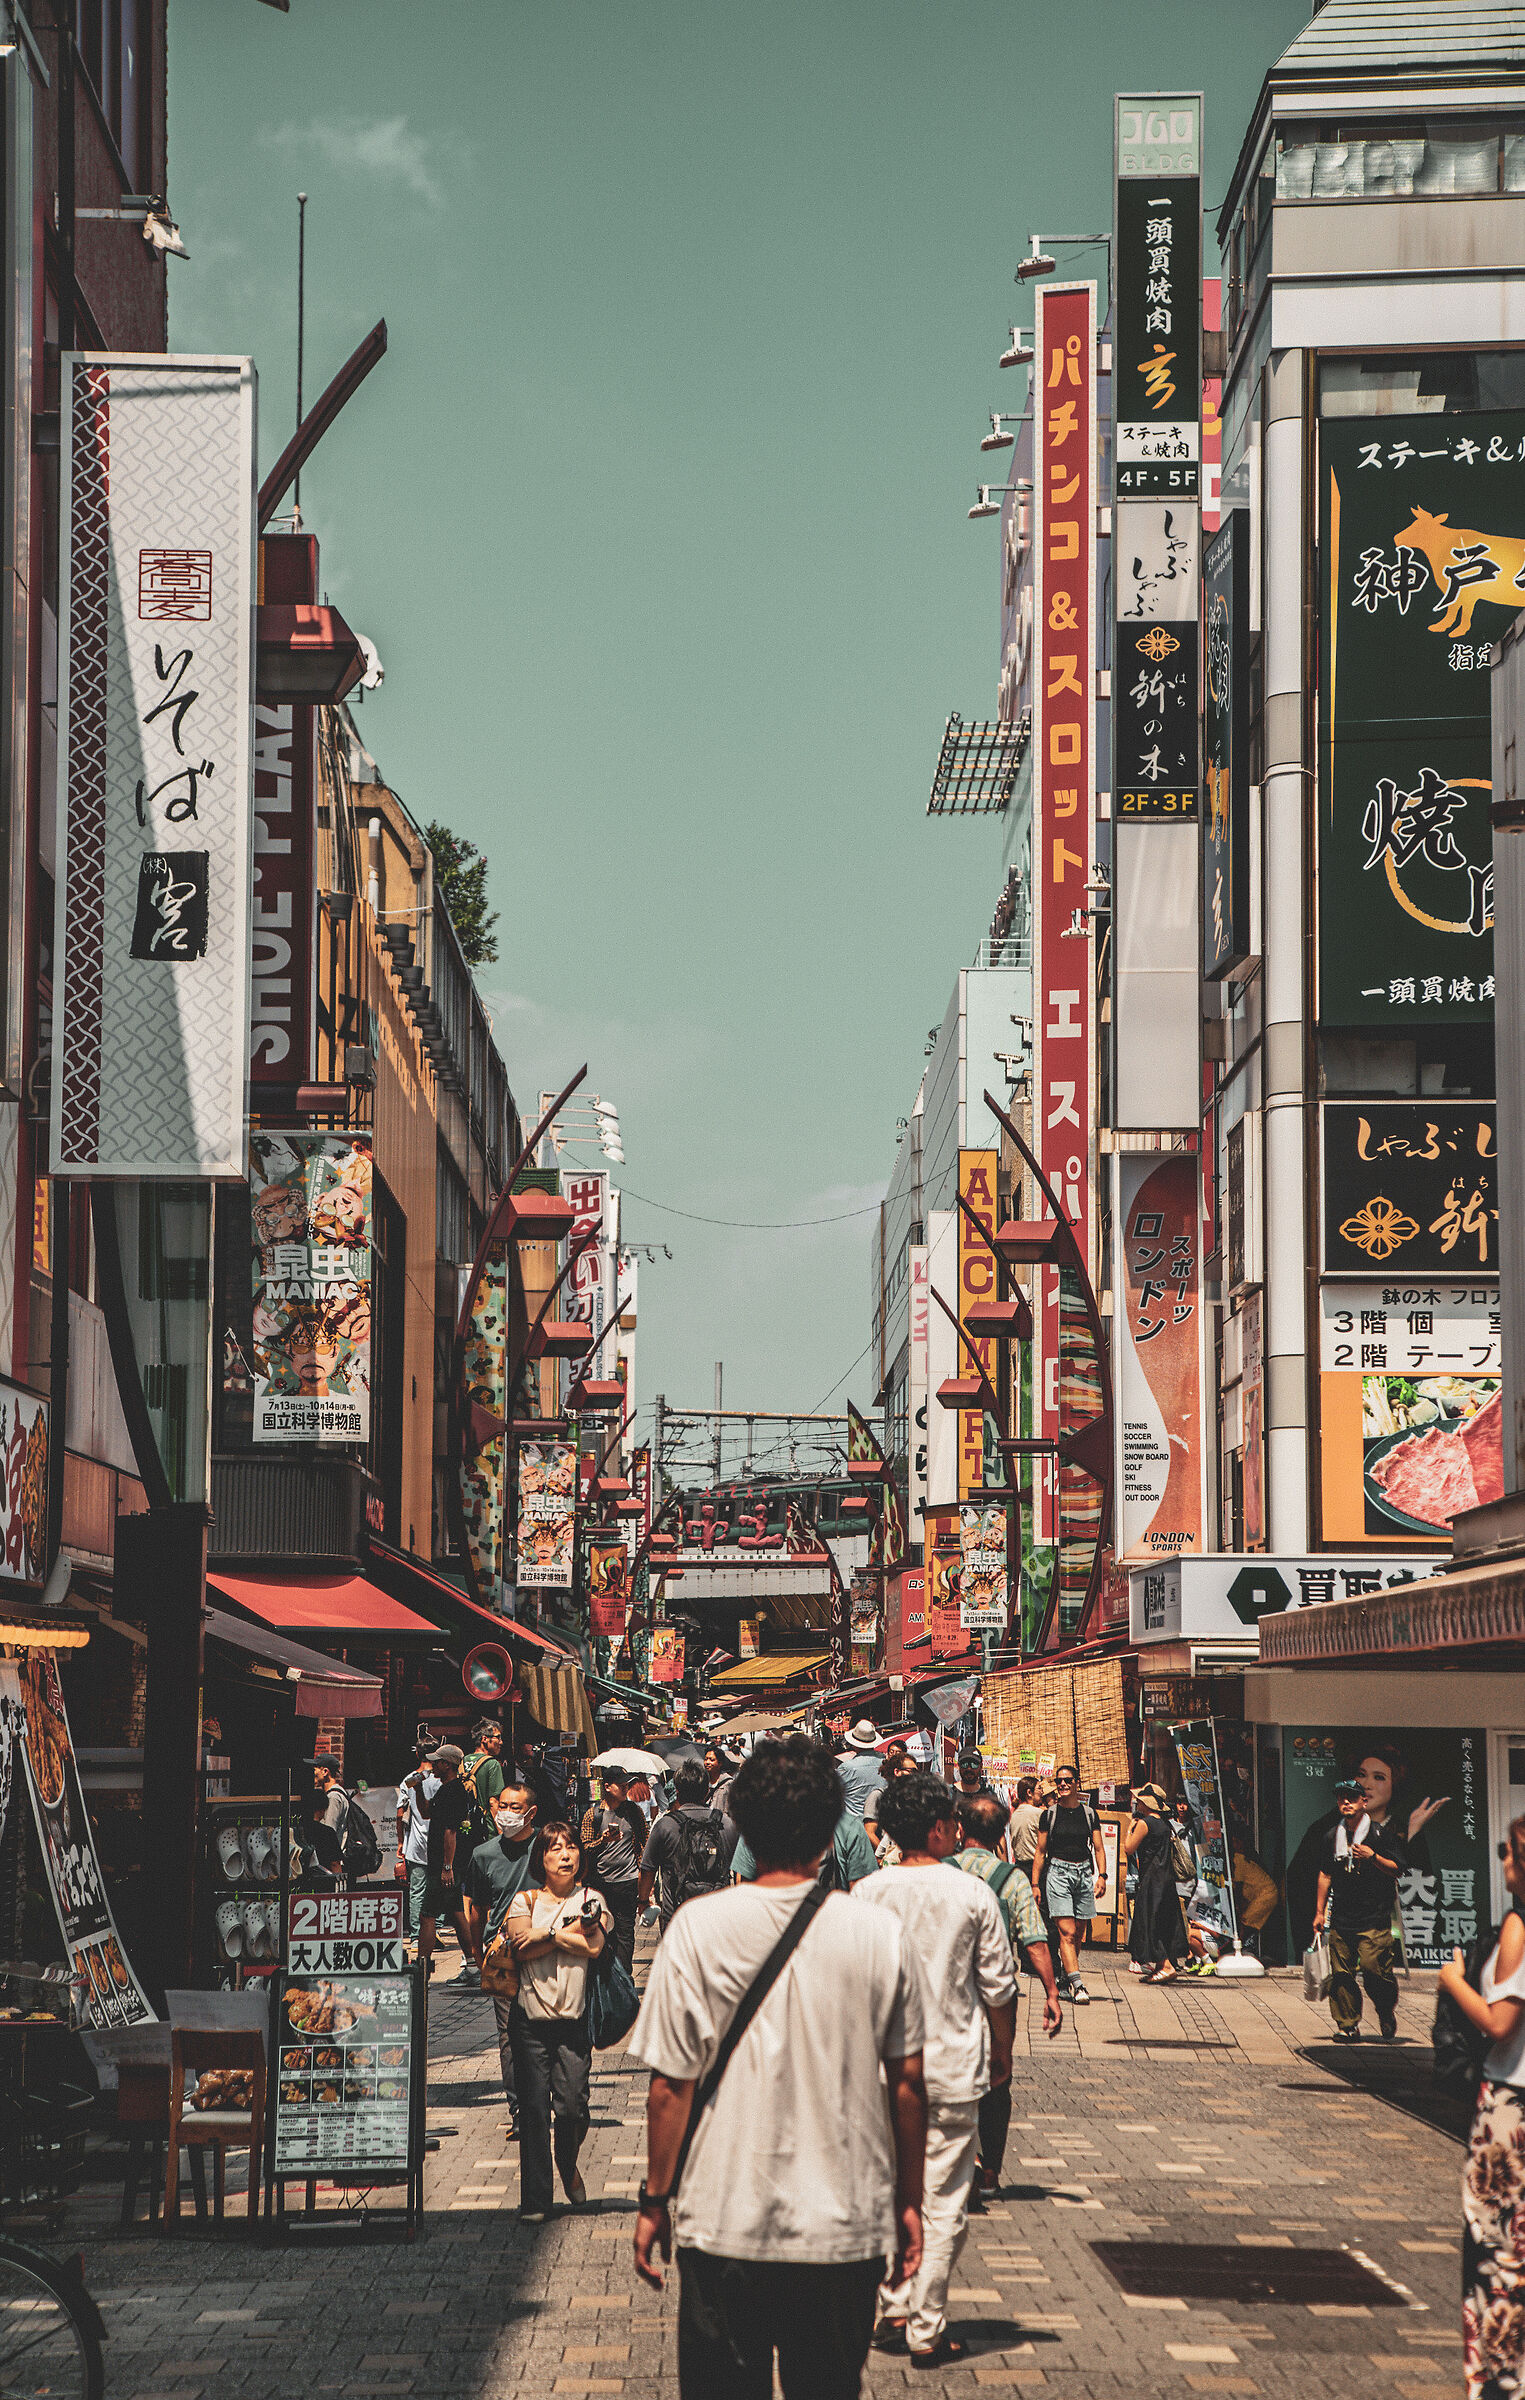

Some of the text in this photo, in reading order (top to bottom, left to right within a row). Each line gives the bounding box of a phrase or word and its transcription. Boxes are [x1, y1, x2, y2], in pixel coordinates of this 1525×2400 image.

[1145, 198, 1174, 335] 一頭買焼肉
[1122, 426, 1183, 441] ステーキ
[1141, 441, 1190, 459] &焼肉
[1357, 435, 1525, 470] ステーキ&
[1351, 543, 1525, 615] 神戸
[266, 1244, 358, 1281] 昆虫
[265, 1282, 359, 1300] MANIAC
[1133, 1211, 1165, 1344] ロンドン
[1170, 1235, 1192, 1326] スポーツ
[1382, 1288, 1442, 1306] 鉢の木
[1333, 1310, 1387, 1335] 3階
[1334, 1342, 1501, 1368] 2階 テーブ
[262, 1412, 361, 1430] 国立科学博物館
[523, 1511, 569, 1521] MANIAC
[1142, 1532, 1195, 1543] LONDON
[1151, 1543, 1182, 1551] SPORTS
[964, 1565, 1002, 1573] MANIAC
[1460, 1737, 1477, 1841] 高く売るなら、大吉。
[292, 1897, 399, 1936] 2階席あり
[1398, 1867, 1439, 1946] 大吉
[1440, 1868, 1478, 1944] 買取
[291, 1941, 399, 1972] 大人数OK
